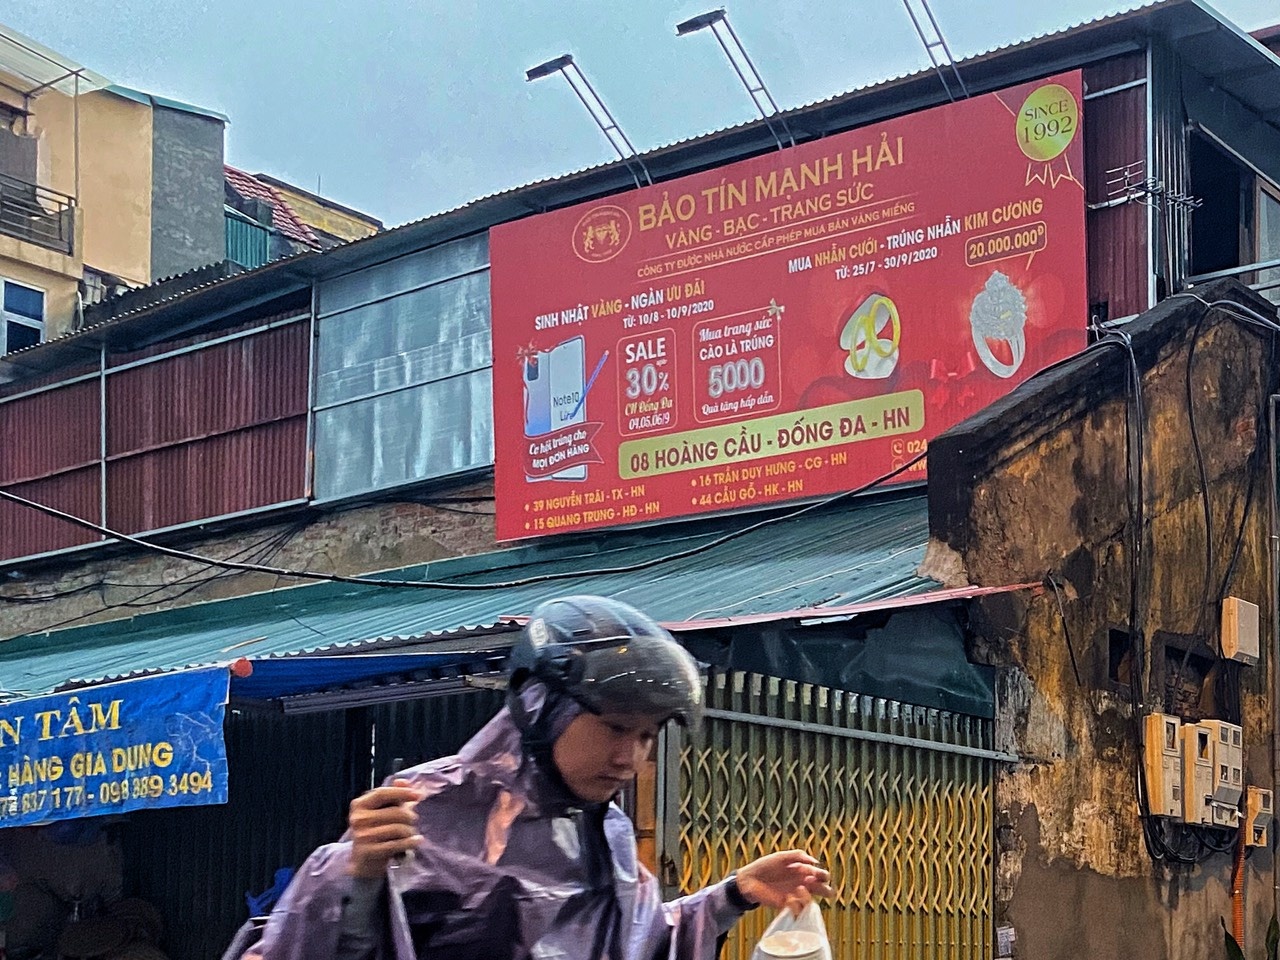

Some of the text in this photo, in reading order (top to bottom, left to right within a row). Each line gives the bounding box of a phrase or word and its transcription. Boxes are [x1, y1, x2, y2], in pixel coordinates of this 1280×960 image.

[1024, 100, 1068, 122] SINCE
[1024, 116, 1072, 144] 1992
[639, 132, 903, 232] BẢO TÍN MẠNH HẢI
[666, 225, 712, 249] VÀNG
[724, 214, 760, 236] BẠC
[770, 194, 831, 223] TRANG
[836, 182, 874, 206] SỨC
[788, 198, 1043, 273] MUA NHẪN CƯỚI TRÚNG NHẪN KIM CƯƠNG
[637, 265, 662, 277] CÔNG
[665, 262, 676, 272] TY
[804, 224, 826, 238] MUA
[852, 260, 875, 277] 25/7
[884, 247, 937, 270] 30/9/2020
[535, 312, 558, 330] SINH
[561, 304, 589, 326] NHẬT
[591, 299, 622, 318] VÀNG
[631, 288, 664, 310] NGÀN
[639, 311, 659, 325] 10/8
[666, 300, 714, 320] 10/9/2020
[699, 316, 772, 342] Mua trang sức
[626, 338, 666, 363] SALE
[700, 334, 774, 360] CÀO LÀ TRÚNG
[626, 364, 670, 399] 30%
[708, 357, 765, 398] 5000
[661, 396, 672, 408] Đa
[702, 403, 719, 416] Quà
[574, 429, 586, 441] cho
[631, 453, 649, 472] 08
[656, 441, 718, 468] HOÀNG
[724, 426, 761, 458] CẦU
[778, 417, 833, 448] ĐỐNG
[840, 415, 866, 437] ĐA
[884, 407, 909, 430] HN
[567, 444, 590, 458] HÀNG
[700, 476, 712, 486] 16
[714, 466, 738, 484] TRẦN
[830, 452, 847, 466] HN
[533, 484, 645, 512] 39 NGUYỄN TRÃI TX HN
[699, 480, 803, 506] 44 CẦU GỖ HK HN
[534, 502, 660, 530] 15 QUANG TRUNG HĐ HN
[35, 696, 124, 741] TÂM
[8, 755, 64, 788] HÀNG
[70, 751, 108, 778] GIA
[167, 770, 212, 796] 3494
